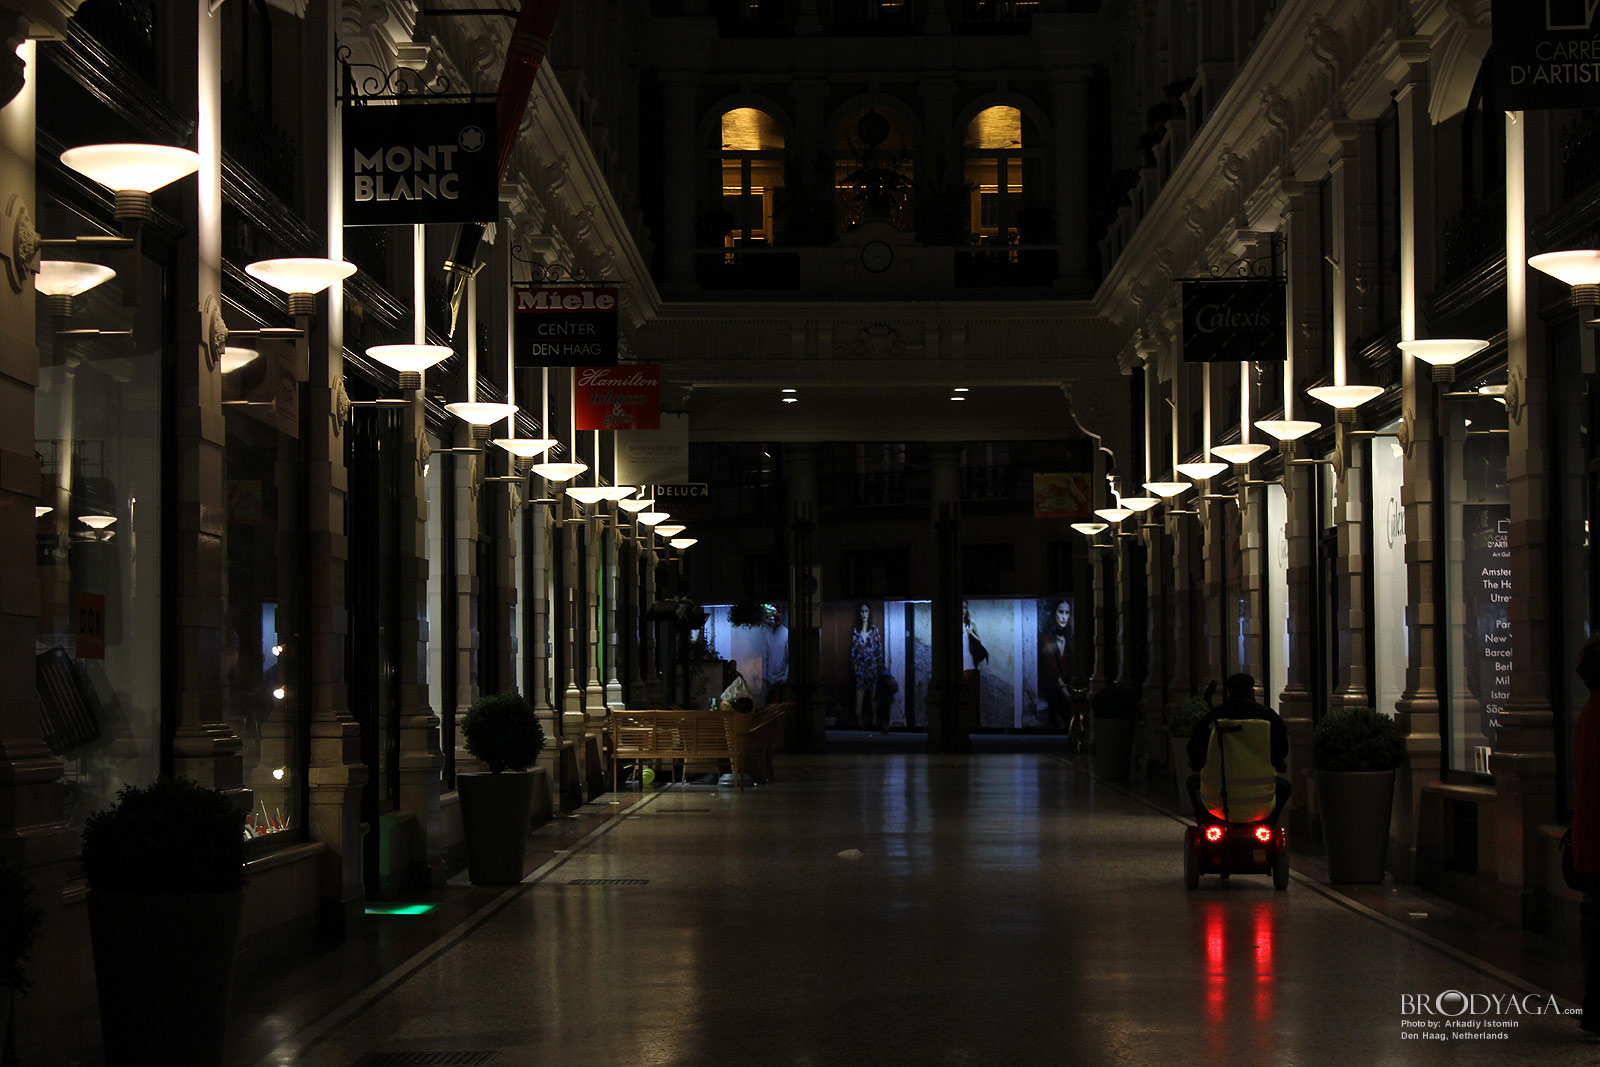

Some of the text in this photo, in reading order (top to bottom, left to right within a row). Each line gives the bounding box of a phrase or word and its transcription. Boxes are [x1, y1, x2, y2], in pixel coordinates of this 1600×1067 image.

[1535, 33, 1600, 61] CARRÉ
[353, 144, 459, 173] MONT
[354, 172, 459, 202] BLANC
[517, 290, 616, 310] Miele
[1195, 303, 1272, 334] Calexis
[537, 320, 596, 336] CENTER
[532, 342, 602, 356] DEN HAAG
[578, 368, 659, 387] Hamilton
[611, 402, 626, 416] &
[657, 486, 709, 497] DELUCA
[1482, 579, 1499, 589] The
[1490, 593, 1512, 603] Utre
[1485, 633, 1507, 643] New
